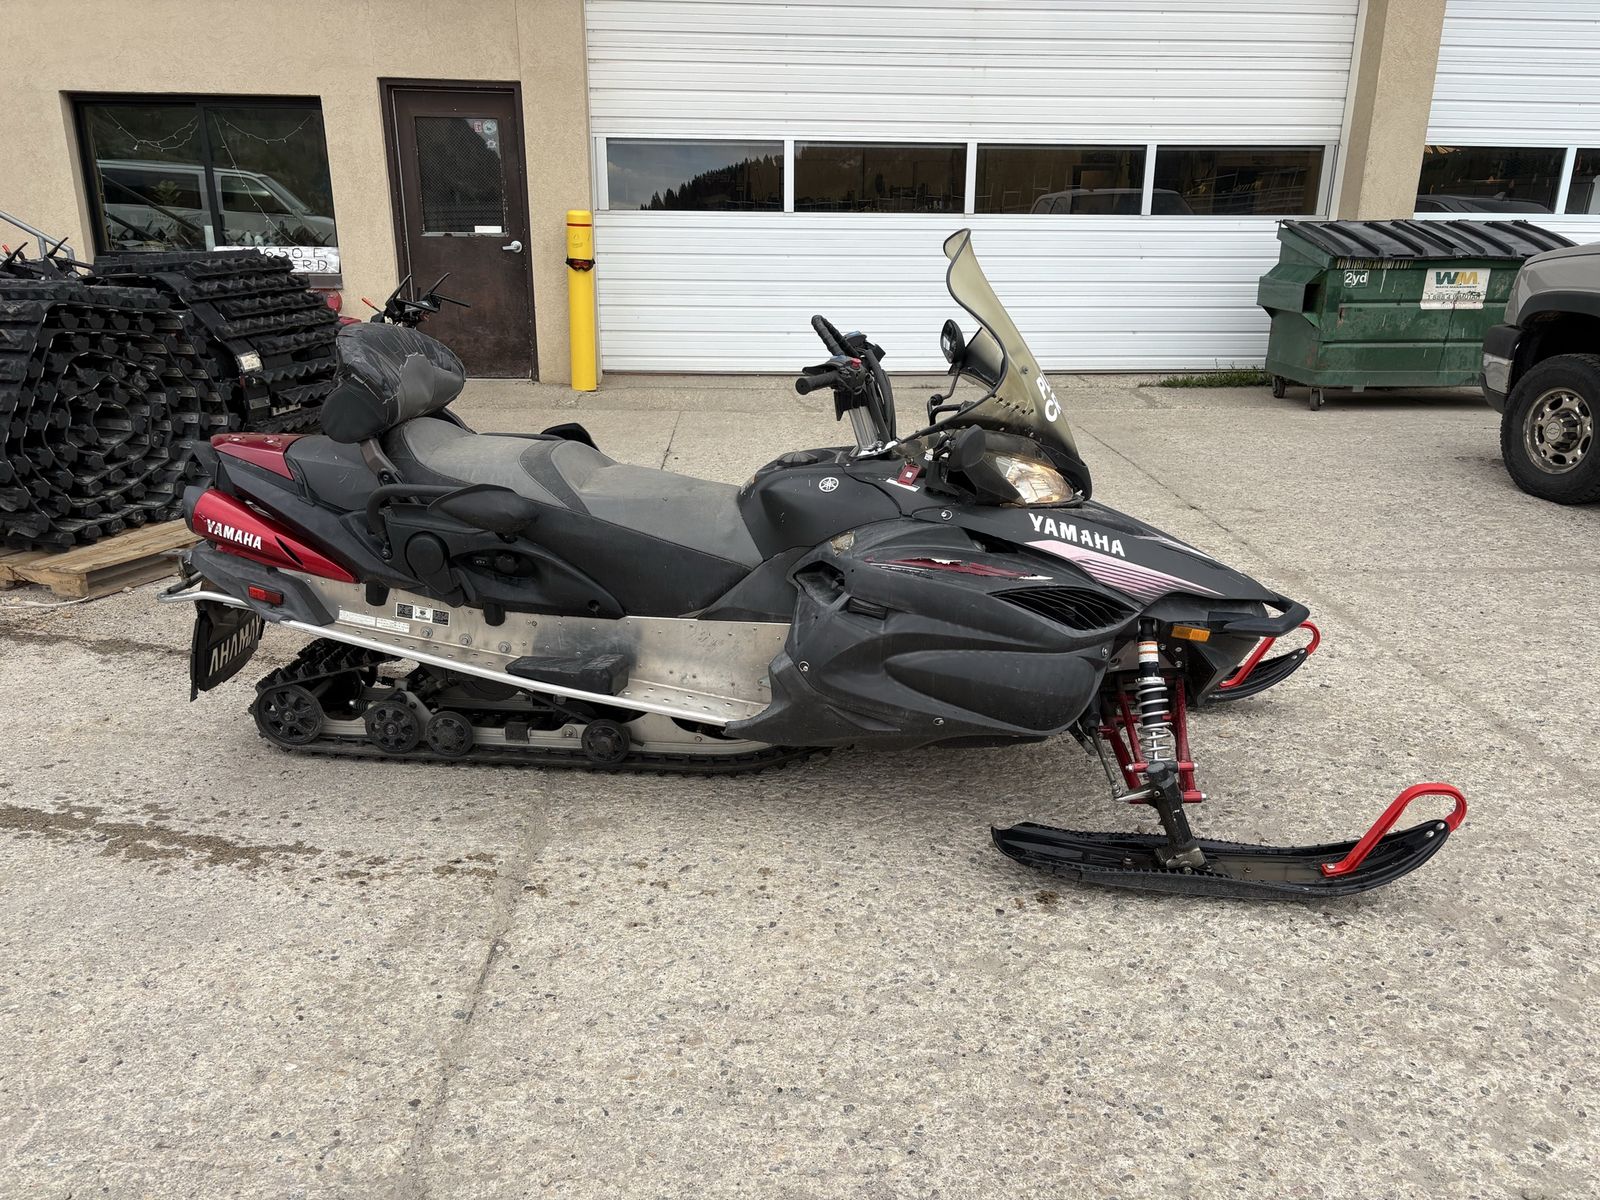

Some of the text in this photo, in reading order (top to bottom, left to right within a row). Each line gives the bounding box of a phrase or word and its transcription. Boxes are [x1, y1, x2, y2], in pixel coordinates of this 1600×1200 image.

[1345, 272, 1368, 286] 2yd
[1435, 271, 1478, 285] WM
[207, 518, 262, 550] YAMAHA
[1028, 512, 1126, 557] YAMAHA
